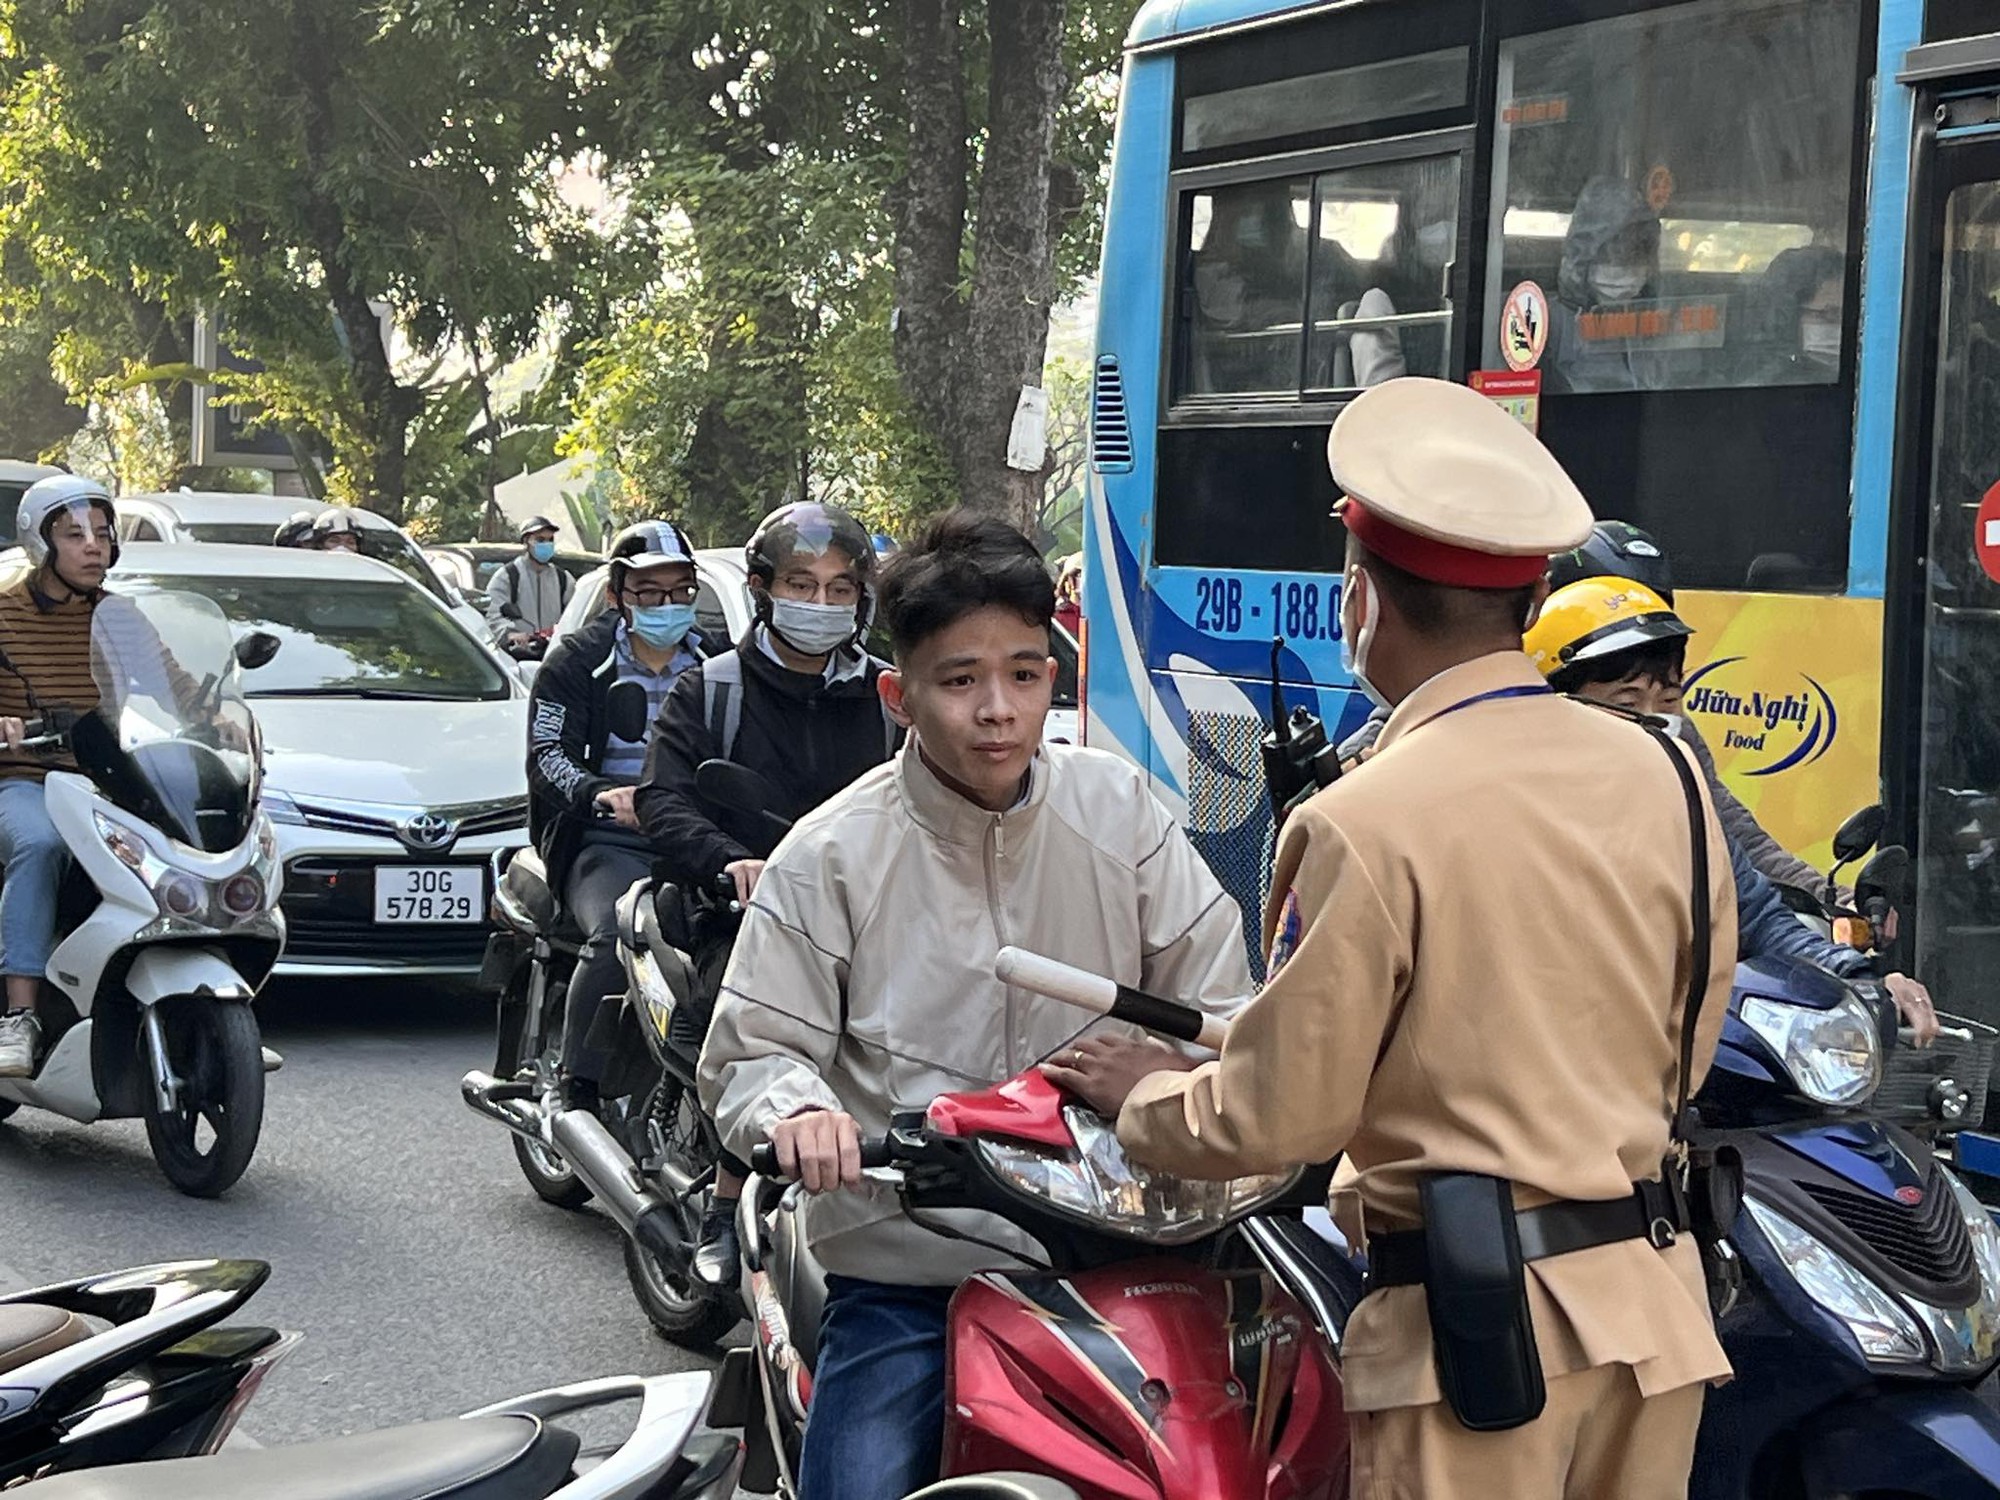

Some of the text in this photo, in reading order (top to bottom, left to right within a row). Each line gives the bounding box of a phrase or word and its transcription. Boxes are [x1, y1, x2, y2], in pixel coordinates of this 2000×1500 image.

[1196, 577, 1242, 633] 29B
[1743, 692, 1809, 732] Nghị
[1724, 728, 1767, 751] Food
[407, 870, 452, 893] 30G
[387, 897, 470, 919] 578.29
[1123, 1282, 1201, 1298] HONDA
